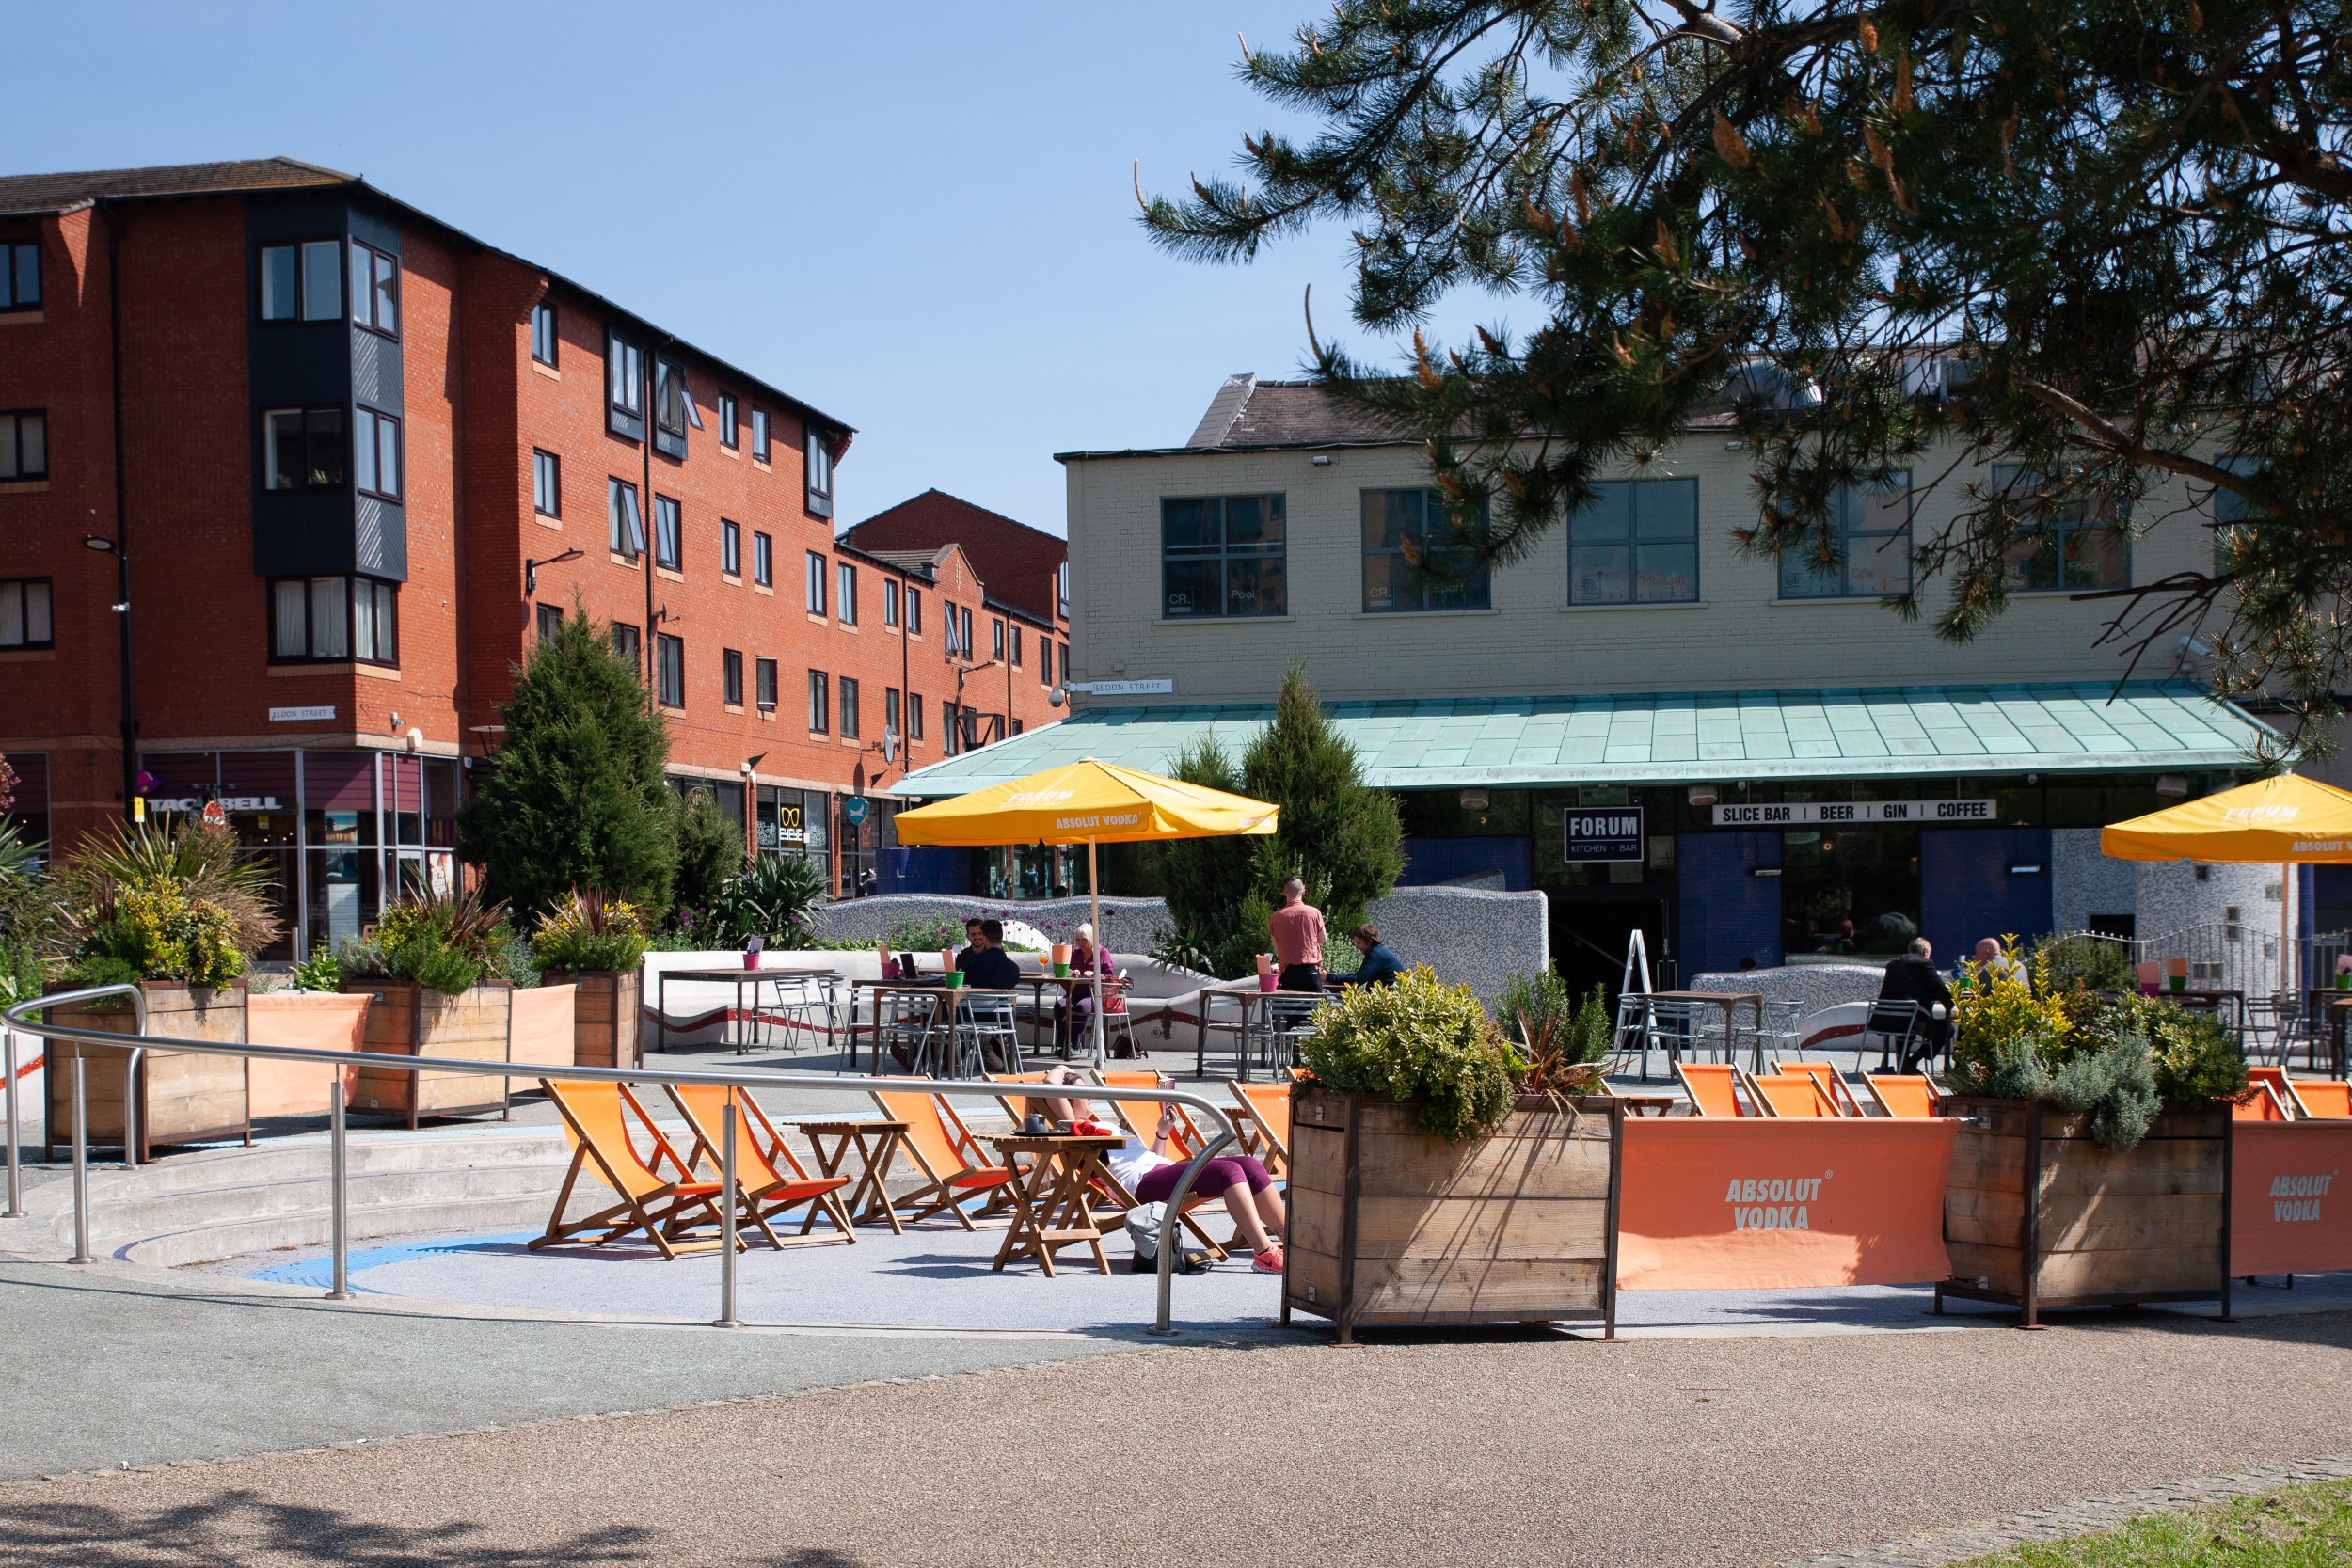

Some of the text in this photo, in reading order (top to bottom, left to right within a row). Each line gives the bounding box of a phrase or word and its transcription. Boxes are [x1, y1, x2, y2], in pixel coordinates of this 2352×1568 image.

[2067, 561, 2099, 572] Food
[1231, 589, 1256, 600] Pool
[1369, 587, 1392, 598] CR.
[1168, 594, 1191, 605] CR.
[1095, 682, 1161, 692] ELDON STREET
[272, 709, 326, 719] ELDON STREET
[147, 797, 283, 812] TAC BELL
[1723, 802, 1988, 822] SLICE BAR BEER GIN COFFEE
[1056, 813, 1138, 830] ABSOLUT VODKA
[1570, 816, 1638, 836] FORUM
[1571, 845, 1607, 853] KITCHEN
[1619, 844, 1638, 852] BAR
[2291, 840, 2344, 852] ABSOLUT
[1724, 1178, 1823, 1202] ABSOLUT
[2268, 1174, 2333, 1197] ABSOLUT
[2274, 1198, 2321, 1223] VODKA
[1733, 1205, 1809, 1231] VODKA
